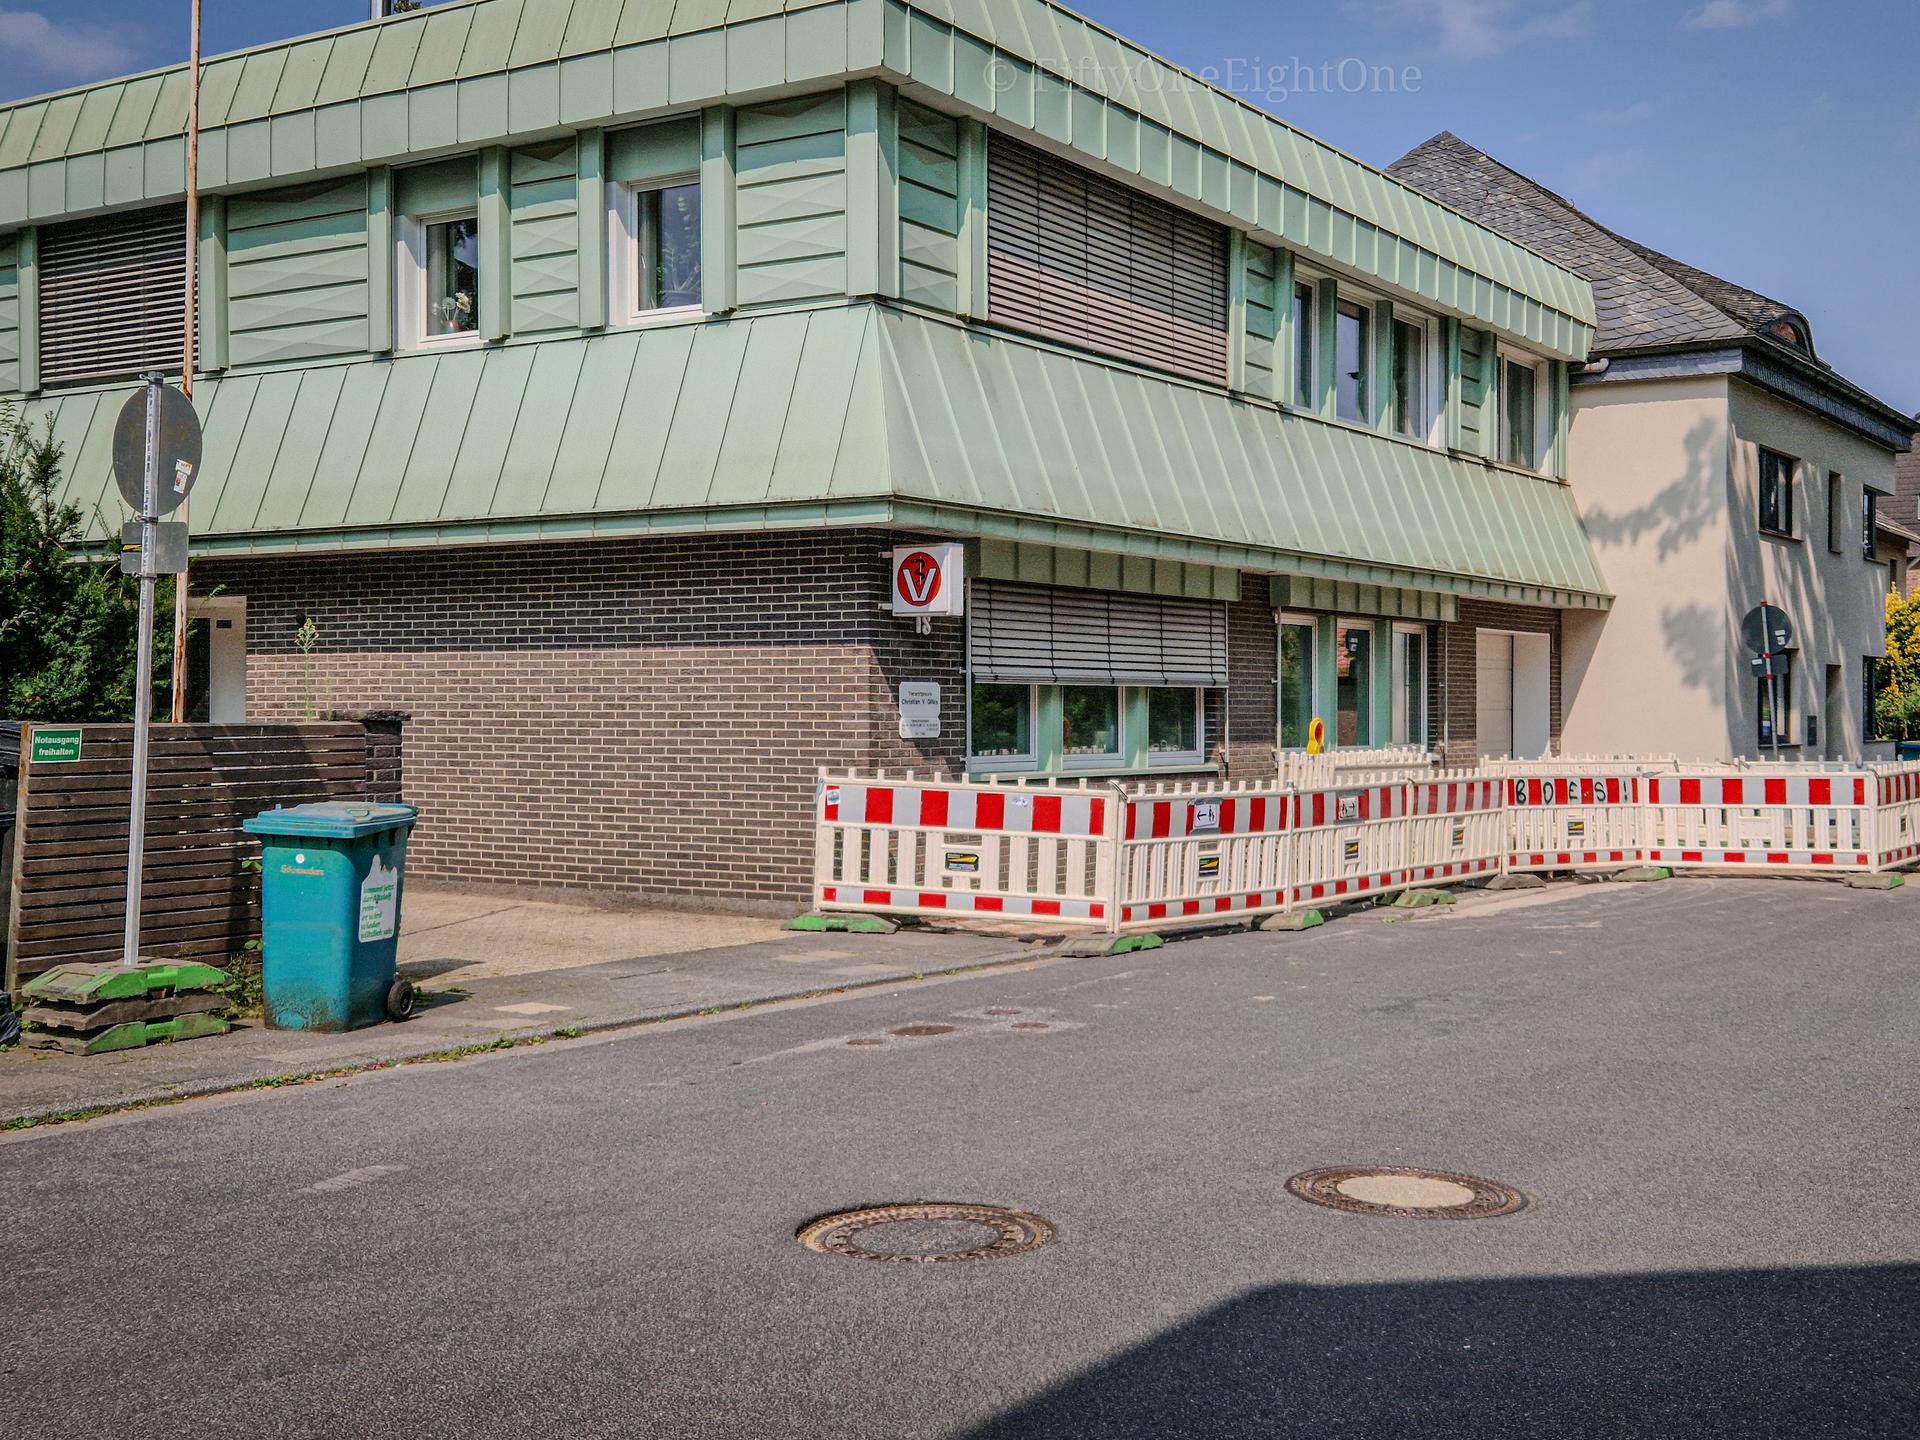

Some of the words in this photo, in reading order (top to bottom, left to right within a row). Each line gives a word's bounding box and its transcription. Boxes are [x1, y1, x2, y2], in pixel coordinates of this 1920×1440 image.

[902, 567, 937, 602] V
[34, 735, 79, 745] Notausgang
[38, 747, 74, 756] freihalten
